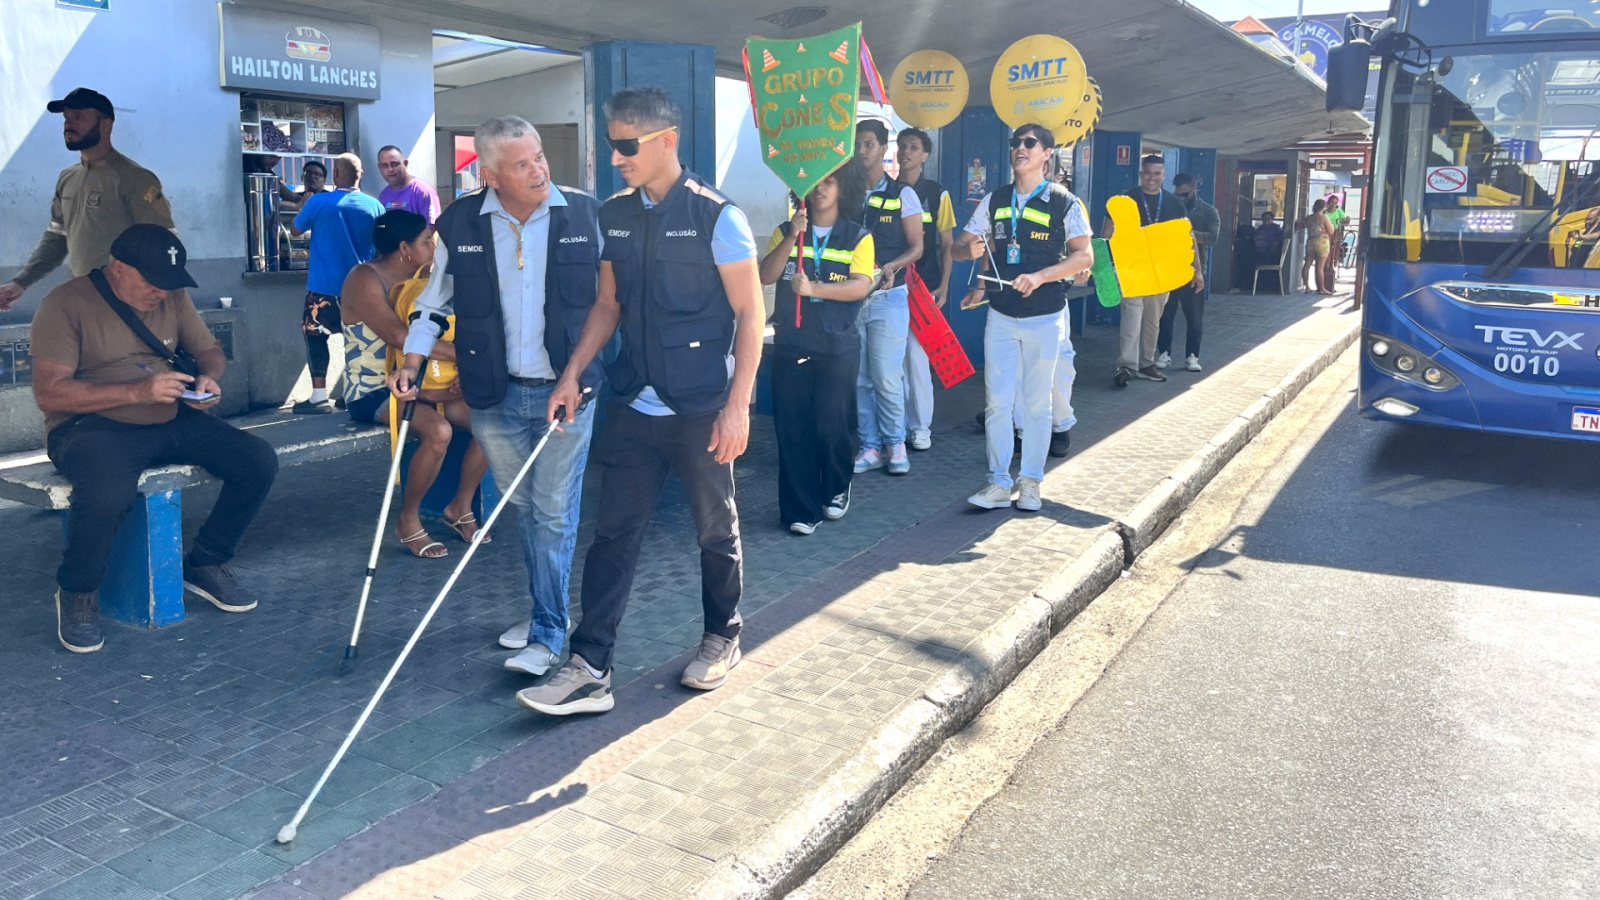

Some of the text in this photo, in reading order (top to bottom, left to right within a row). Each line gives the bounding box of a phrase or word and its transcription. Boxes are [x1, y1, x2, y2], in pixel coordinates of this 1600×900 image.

[231, 55, 377, 89] HAILTON LANCHES
[1007, 57, 1067, 82] SMTT
[764, 67, 844, 94] GRUPO
[904, 70, 955, 85] SMTT
[760, 92, 852, 139] CONES
[1063, 118, 1083, 128] ITO
[559, 236, 588, 244] NCLUSÃO
[665, 229, 697, 237] INCLUSÃO
[1030, 231, 1050, 241] SMTT
[457, 245, 483, 253] SEMDE
[828, 272, 848, 282] SMTT
[1474, 325, 1585, 351] TEVX
[1493, 352, 1560, 377] 0010
